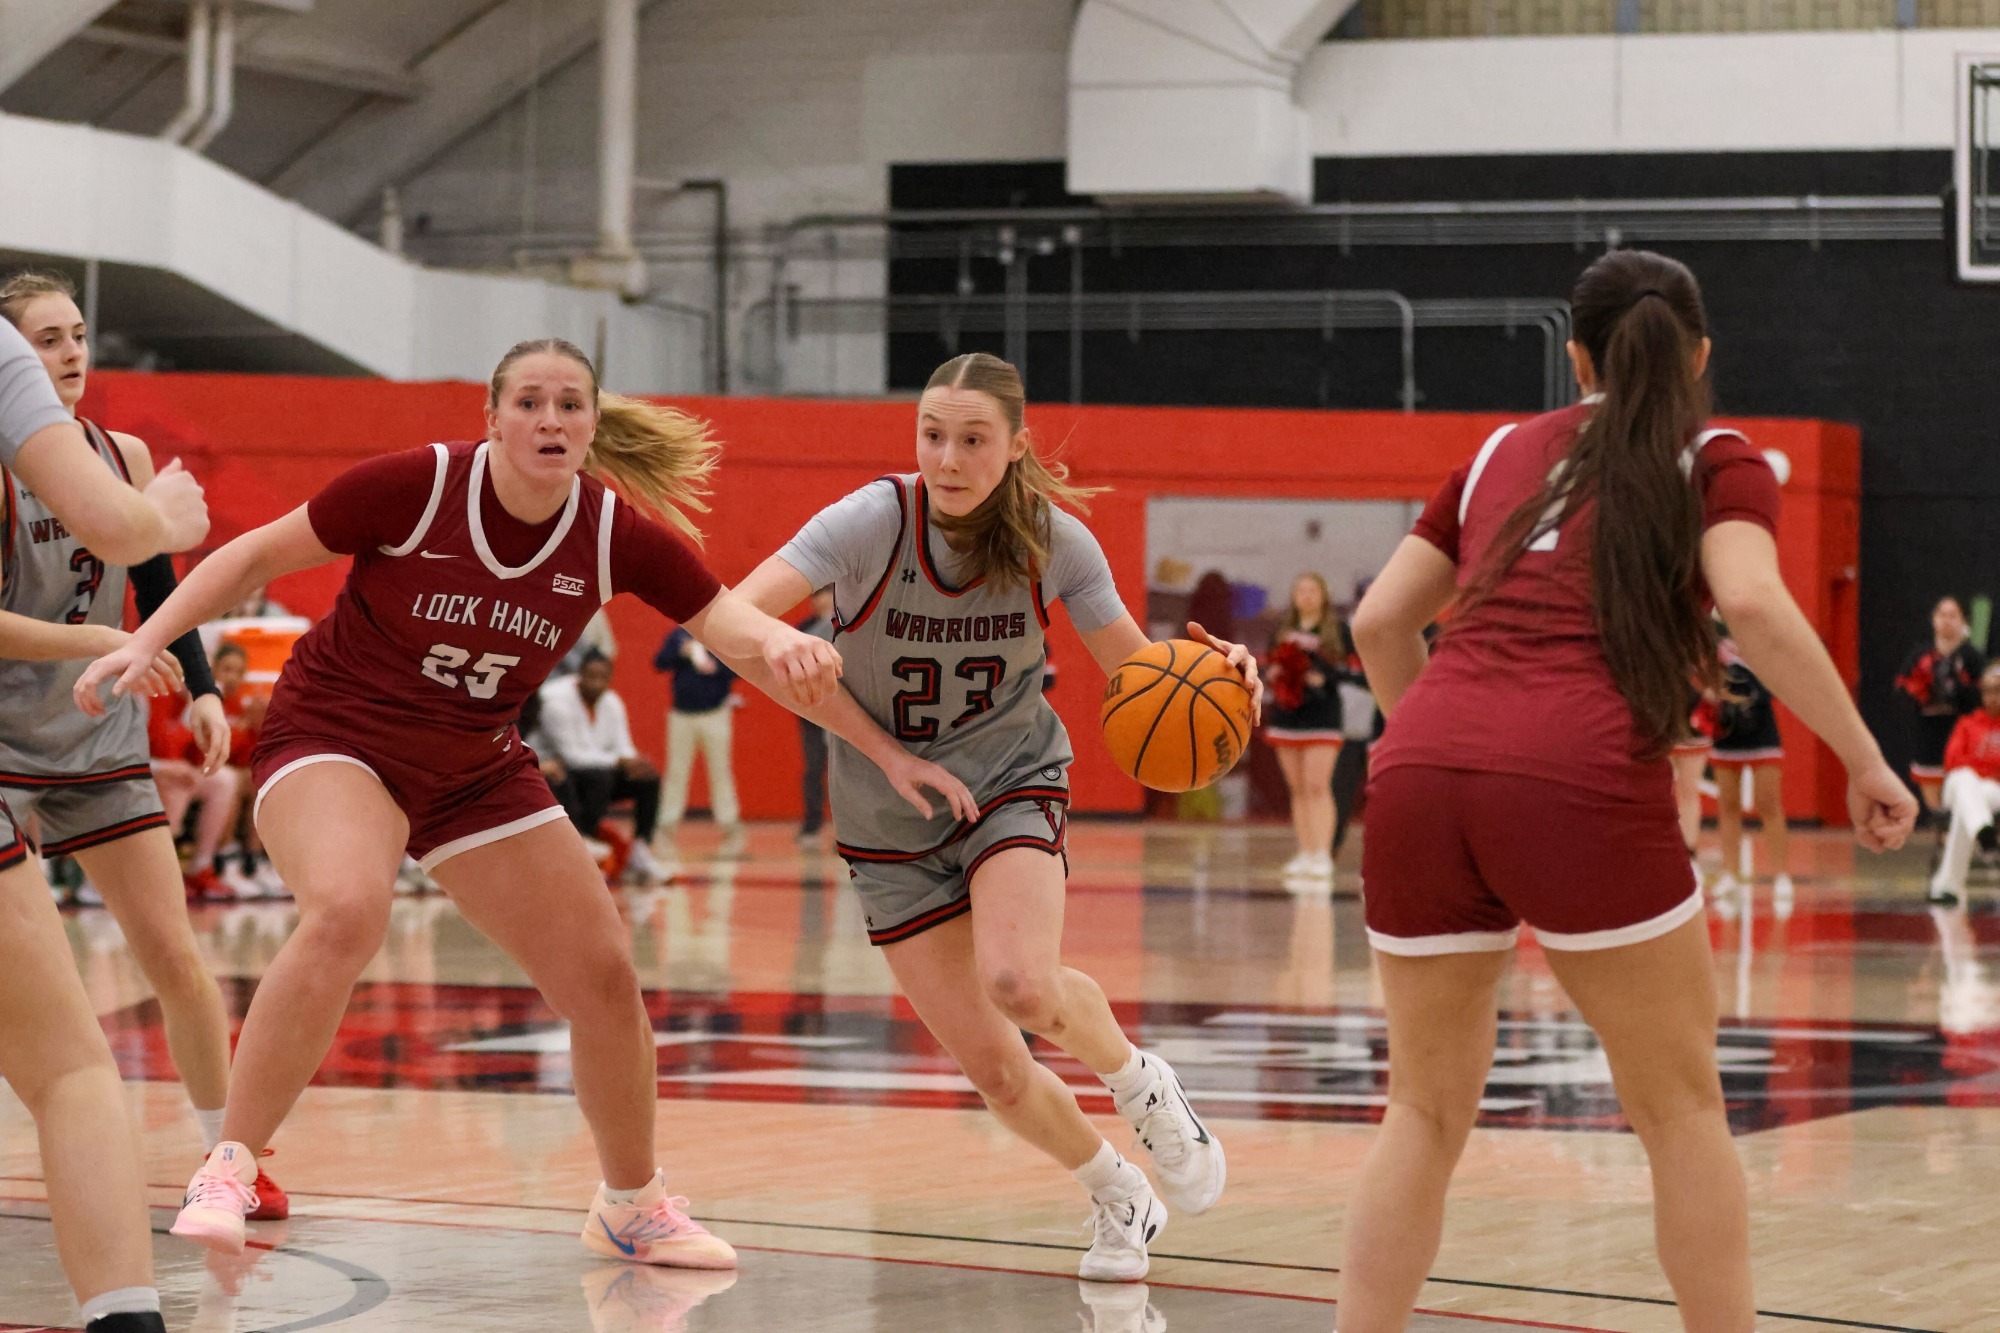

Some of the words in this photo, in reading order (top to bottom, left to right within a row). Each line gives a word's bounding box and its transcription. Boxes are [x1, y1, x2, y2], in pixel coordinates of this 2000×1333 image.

[553, 577, 585, 592] PSAC
[412, 593, 483, 626] LOCK
[489, 600, 562, 651] HAVEN
[885, 608, 1026, 643] WARRIORS
[421, 643, 521, 699] 25
[892, 655, 1007, 743] 23
